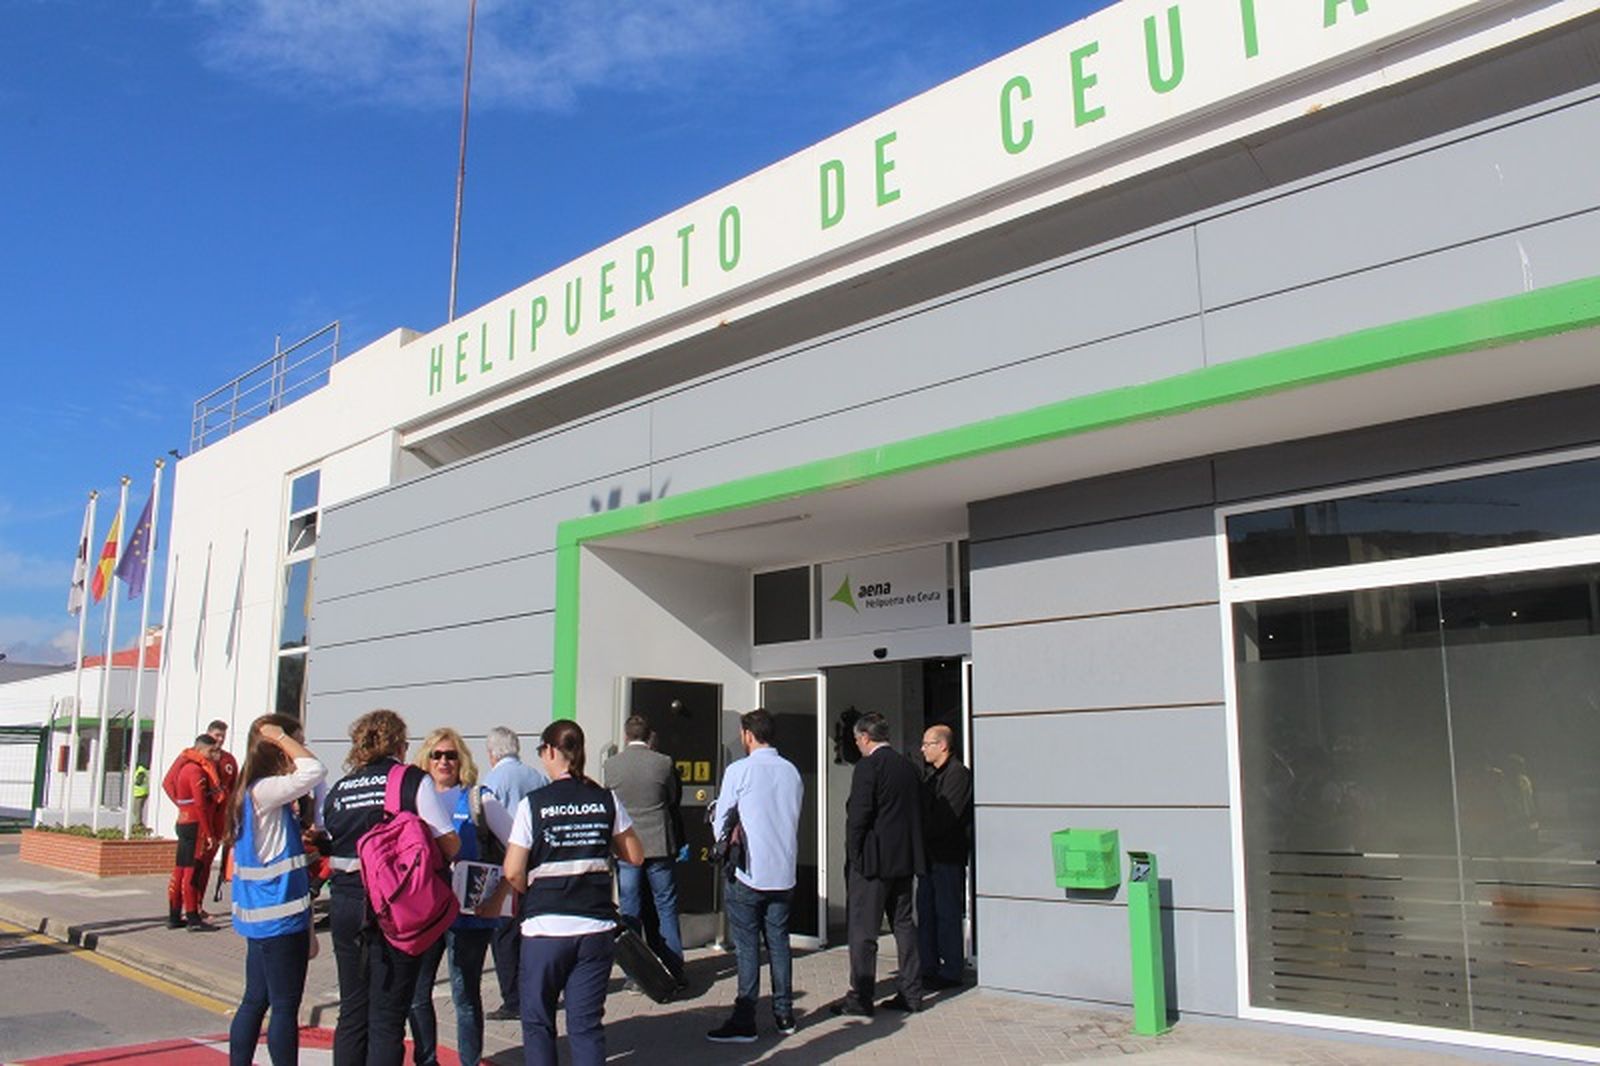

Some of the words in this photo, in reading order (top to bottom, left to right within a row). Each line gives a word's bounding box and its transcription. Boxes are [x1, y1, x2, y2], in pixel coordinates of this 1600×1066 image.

[428, 205, 741, 396] HELIPUERTO
[820, 130, 901, 230] DE
[999, 0, 1369, 155] CEU
[858, 582, 891, 598] aena
